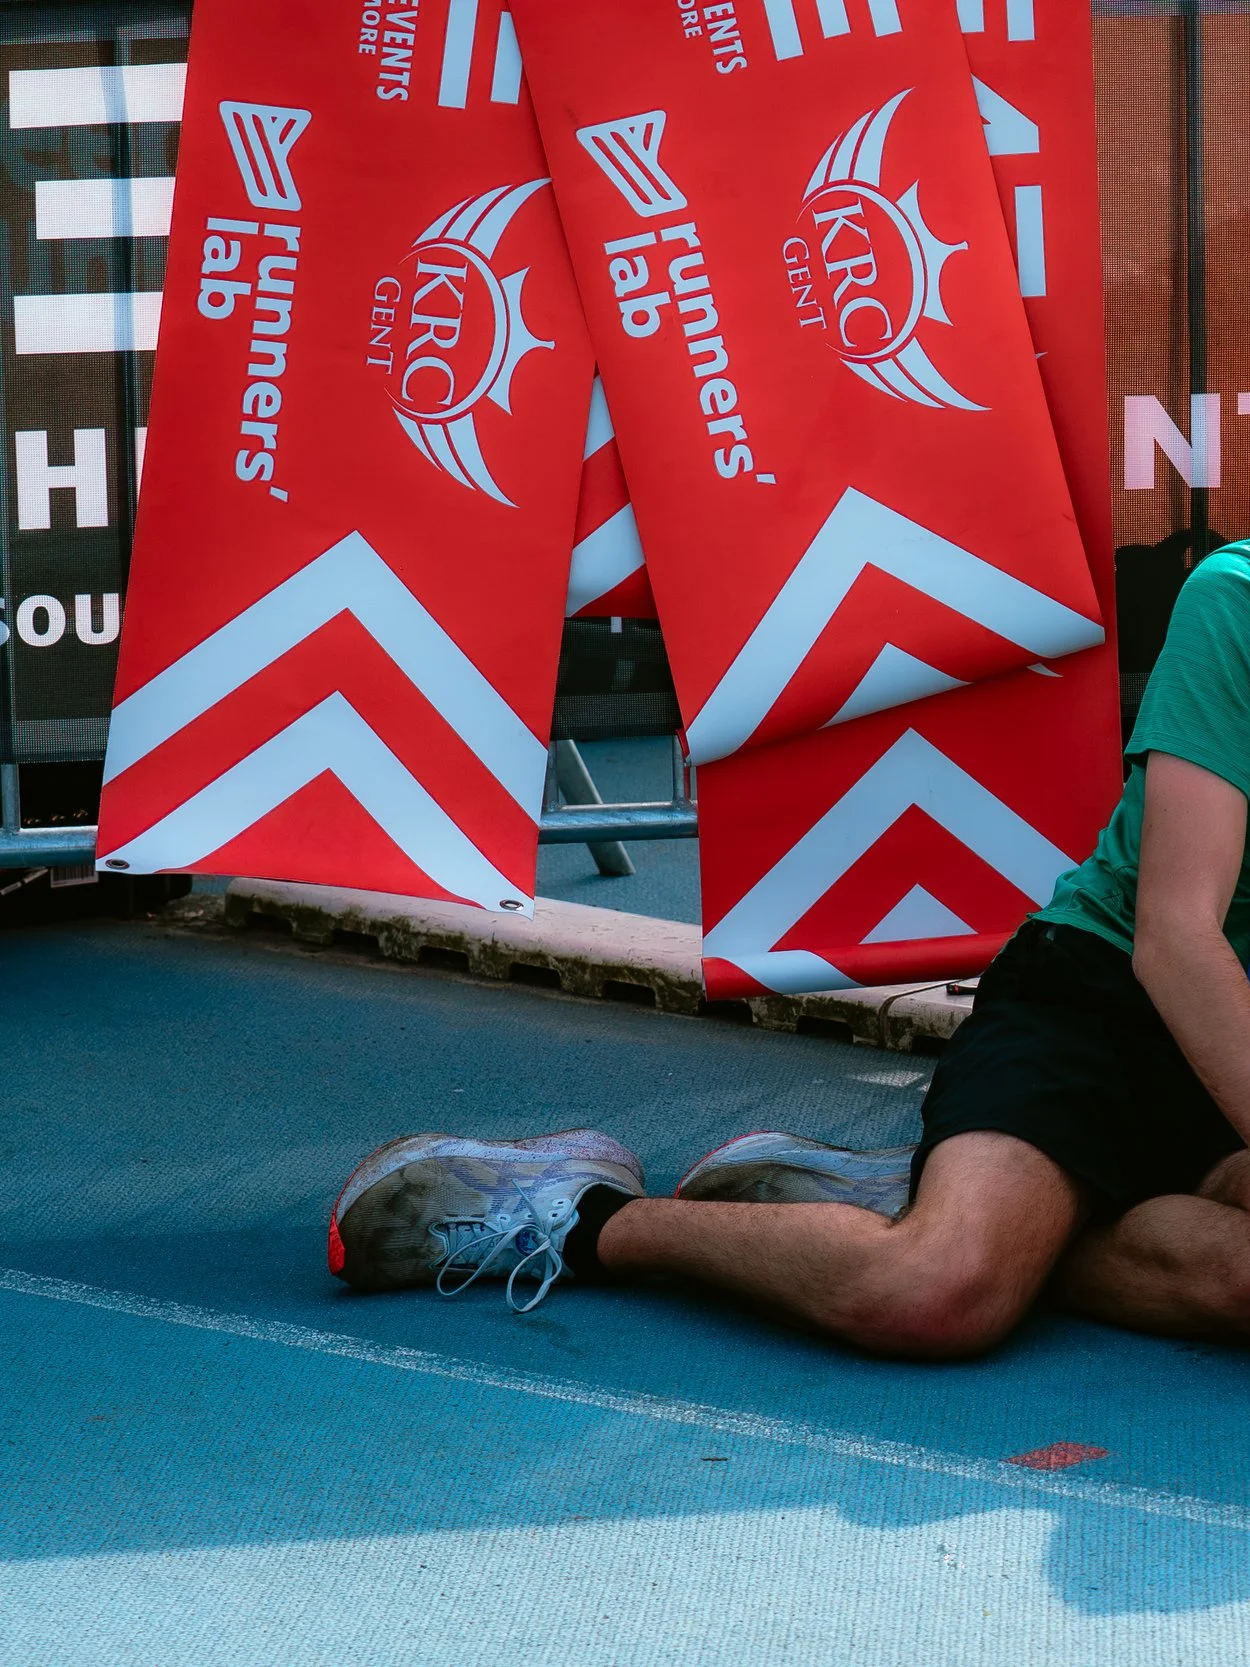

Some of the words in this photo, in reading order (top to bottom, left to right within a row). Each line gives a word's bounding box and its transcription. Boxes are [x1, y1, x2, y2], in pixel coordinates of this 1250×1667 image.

[197, 216, 259, 319] lab
[365, 276, 401, 374] GENT
[603, 232, 671, 338] lab
[782, 236, 827, 330] GENT
[813, 197, 894, 348] KRC
[235, 224, 301, 502] runners'
[401, 257, 468, 406] KRC
[661, 221, 776, 485] runners'
